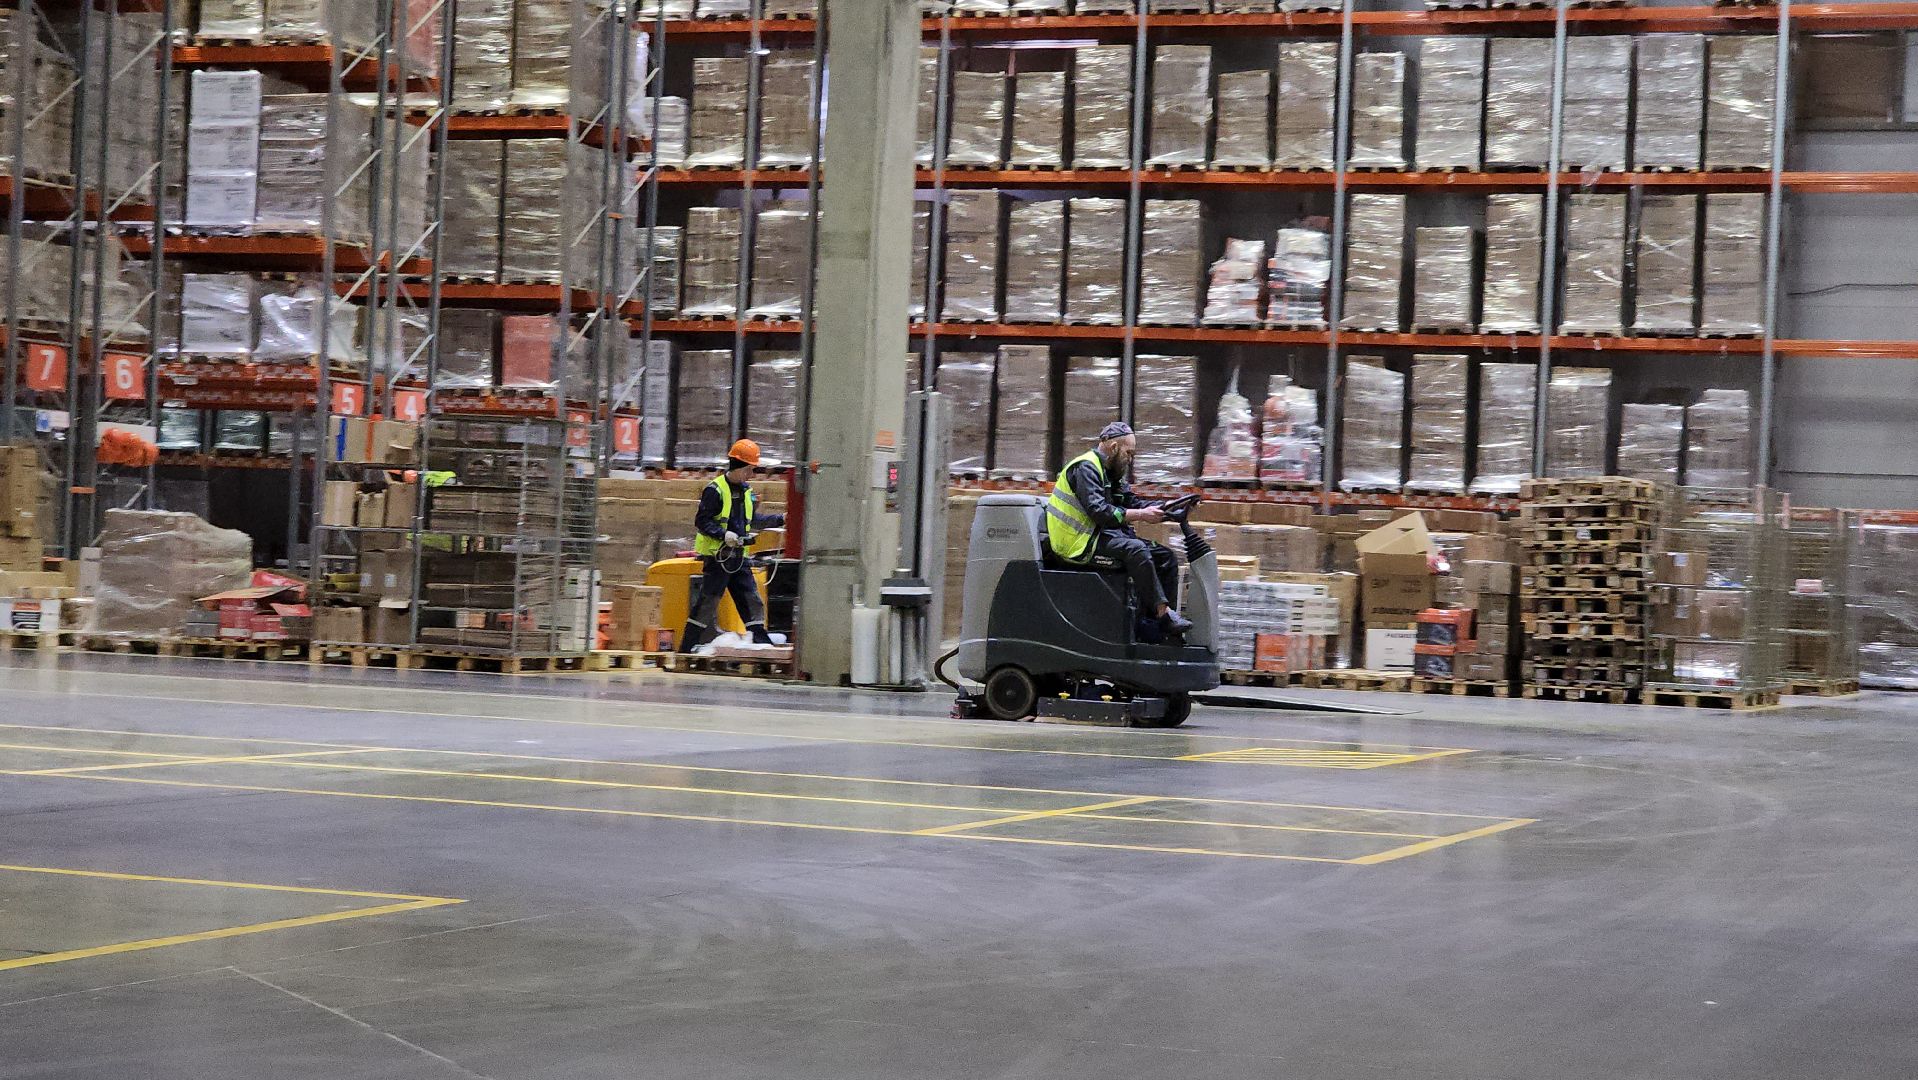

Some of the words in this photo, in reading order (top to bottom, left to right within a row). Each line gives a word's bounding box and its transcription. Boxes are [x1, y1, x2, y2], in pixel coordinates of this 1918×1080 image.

[40, 349, 56, 380] 7
[116, 359, 133, 389] 6
[342, 388, 355, 414] 5
[404, 396, 418, 420] 4
[620, 421, 633, 445] 2
